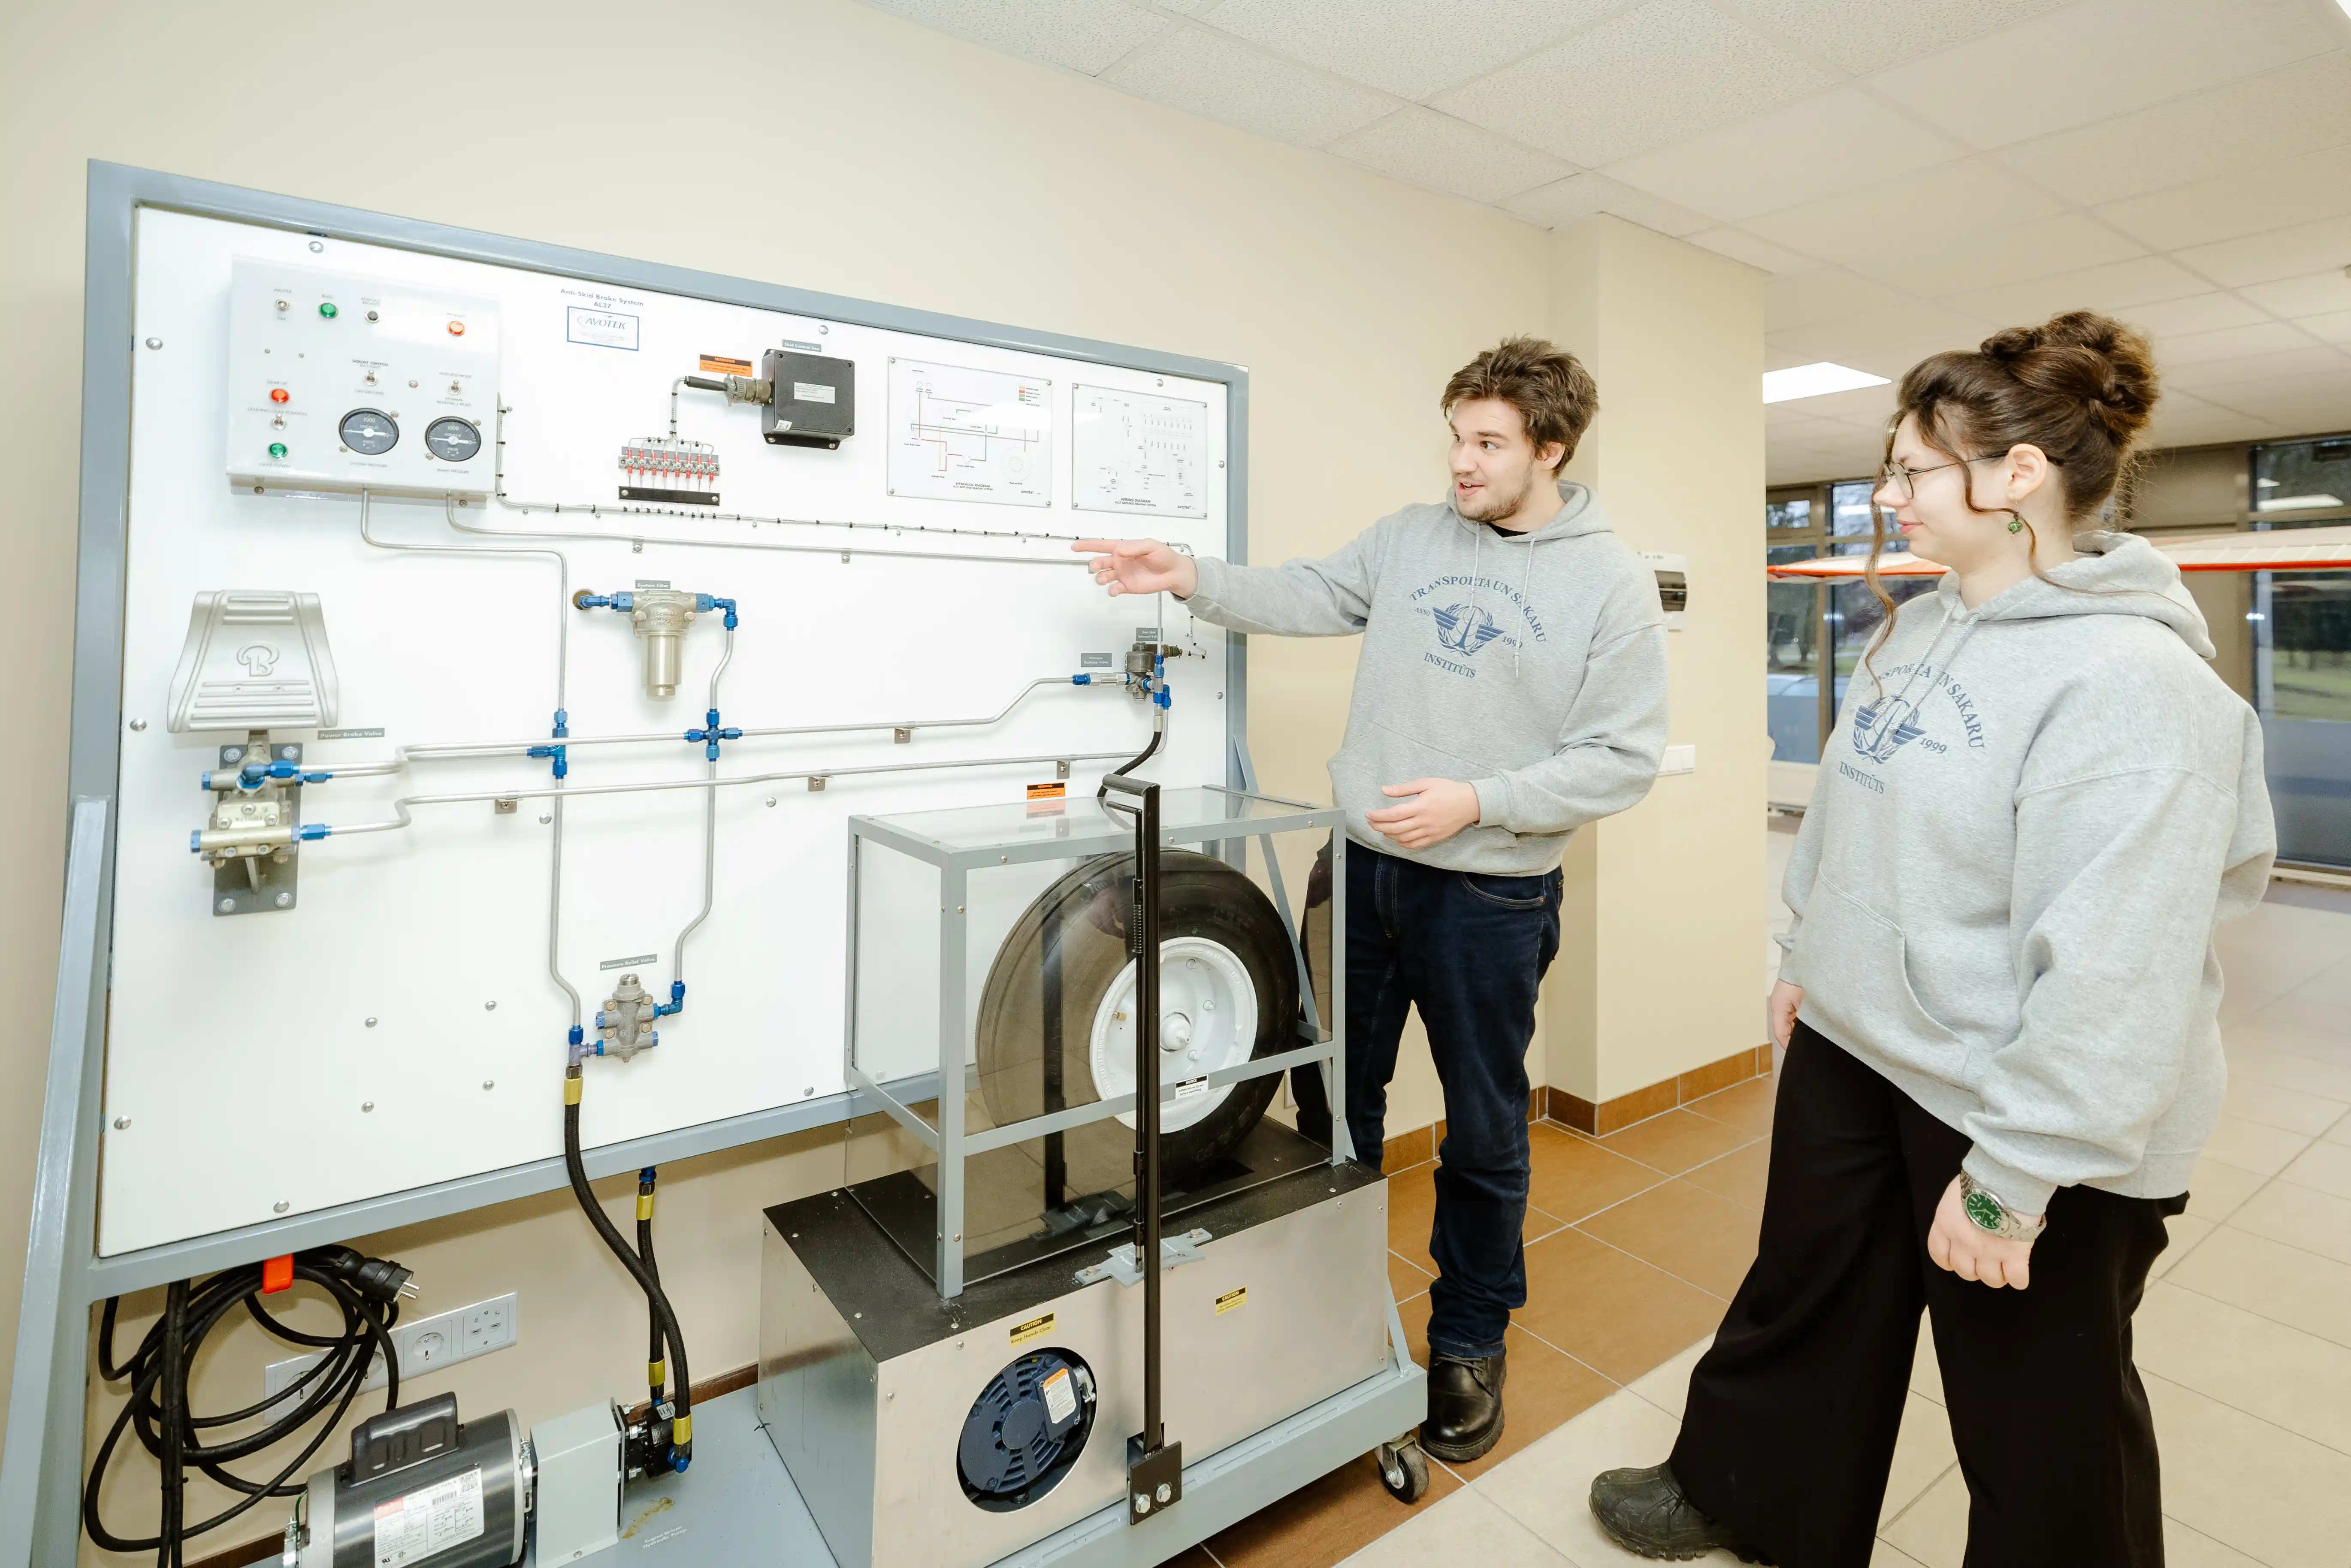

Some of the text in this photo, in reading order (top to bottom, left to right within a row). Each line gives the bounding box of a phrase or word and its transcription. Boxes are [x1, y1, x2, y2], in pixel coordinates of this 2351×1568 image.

[560, 288, 644, 306] Anti-Skid Brake System
[584, 317, 627, 329] AVOTEK
[1493, 580, 1514, 595] UN
[1414, 607, 1431, 616] ANNO
[1423, 652, 1476, 678] INSTITŪTS
[1946, 683, 1985, 749] SAKARU
[1919, 737, 1947, 754] 1999
[1839, 761, 1885, 794] INSTITŪTS
[1222, 1290, 1239, 1301] CAUTION
[1020, 1318, 1042, 1331] CAUTION
[1024, 1329, 1038, 1339] Hands
